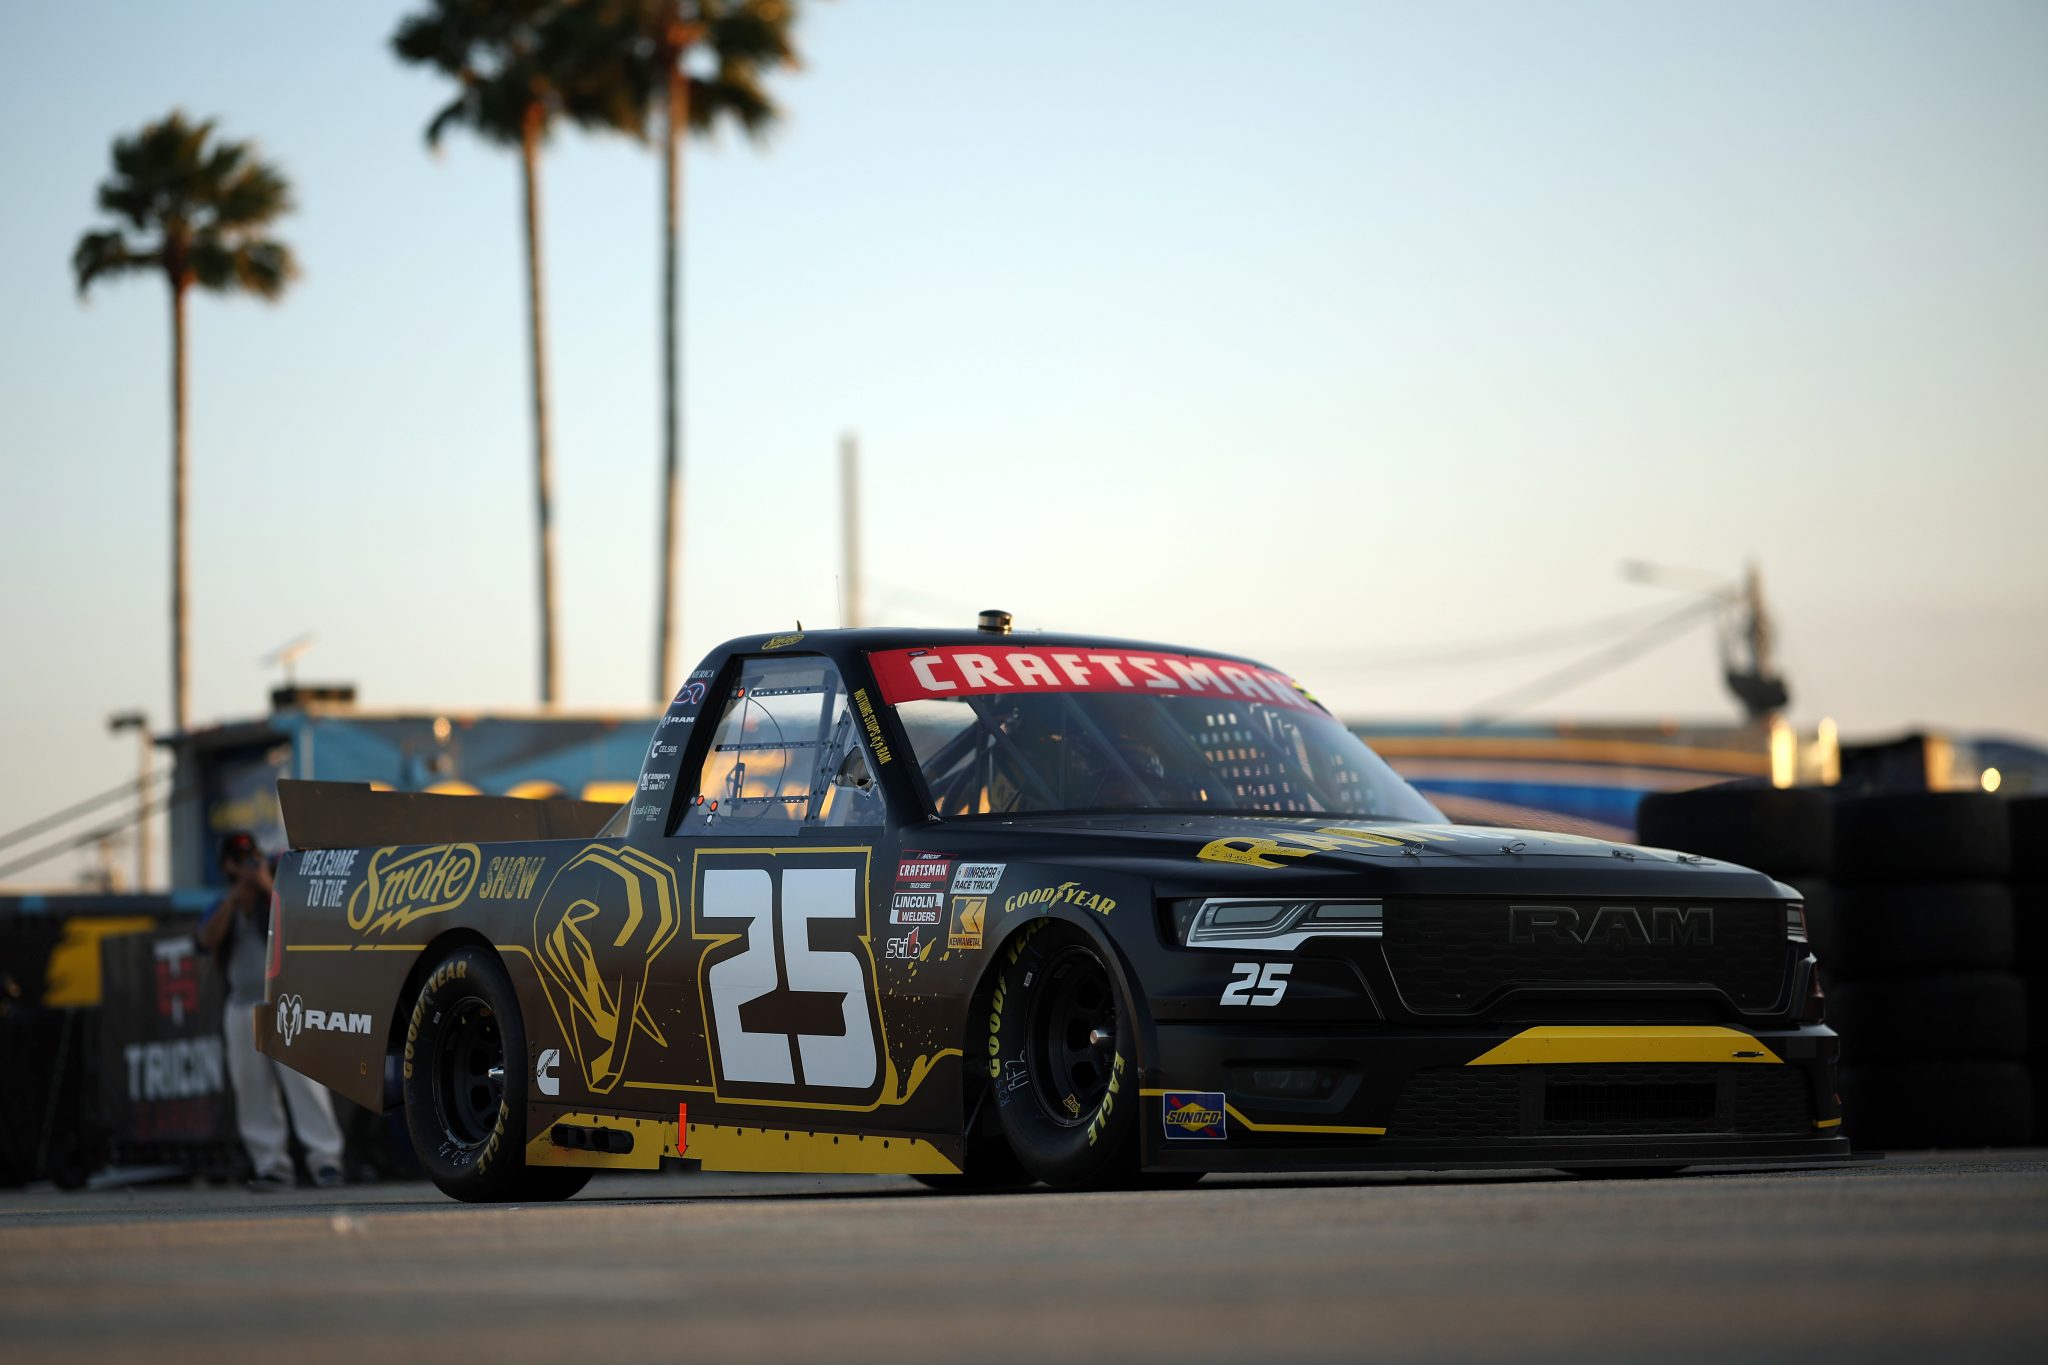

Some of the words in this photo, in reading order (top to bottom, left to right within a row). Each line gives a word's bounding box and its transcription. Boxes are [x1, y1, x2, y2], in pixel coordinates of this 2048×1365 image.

[909, 653, 1311, 709] CRAFTSMAN
[854, 688, 873, 718] NOTHING
[864, 714, 881, 737] STOPS
[875, 746, 893, 765] RAM
[299, 849, 360, 877] WELCOME
[899, 864, 948, 877] CRAFTSMAN
[970, 866, 998, 878] NASCAR
[347, 843, 478, 931] Smoke
[479, 856, 546, 899] SHOW
[954, 880, 972, 889] RACE
[972, 881, 995, 890] TRUCK
[306, 879, 323, 907] TO
[322, 879, 348, 907] THE
[895, 896, 935, 908] LINCOLN
[901, 911, 936, 922] WELDERS
[1509, 905, 1714, 945] RAM
[703, 868, 877, 1088] 25
[1220, 962, 1293, 1006] 25
[305, 1009, 372, 1034] RAM
[537, 1050, 558, 1077] Cummins
[1088, 1051, 1126, 1147] EAGLE
[1168, 1111, 1220, 1123] SUNOCO
[476, 1099, 510, 1176] EAGLE
